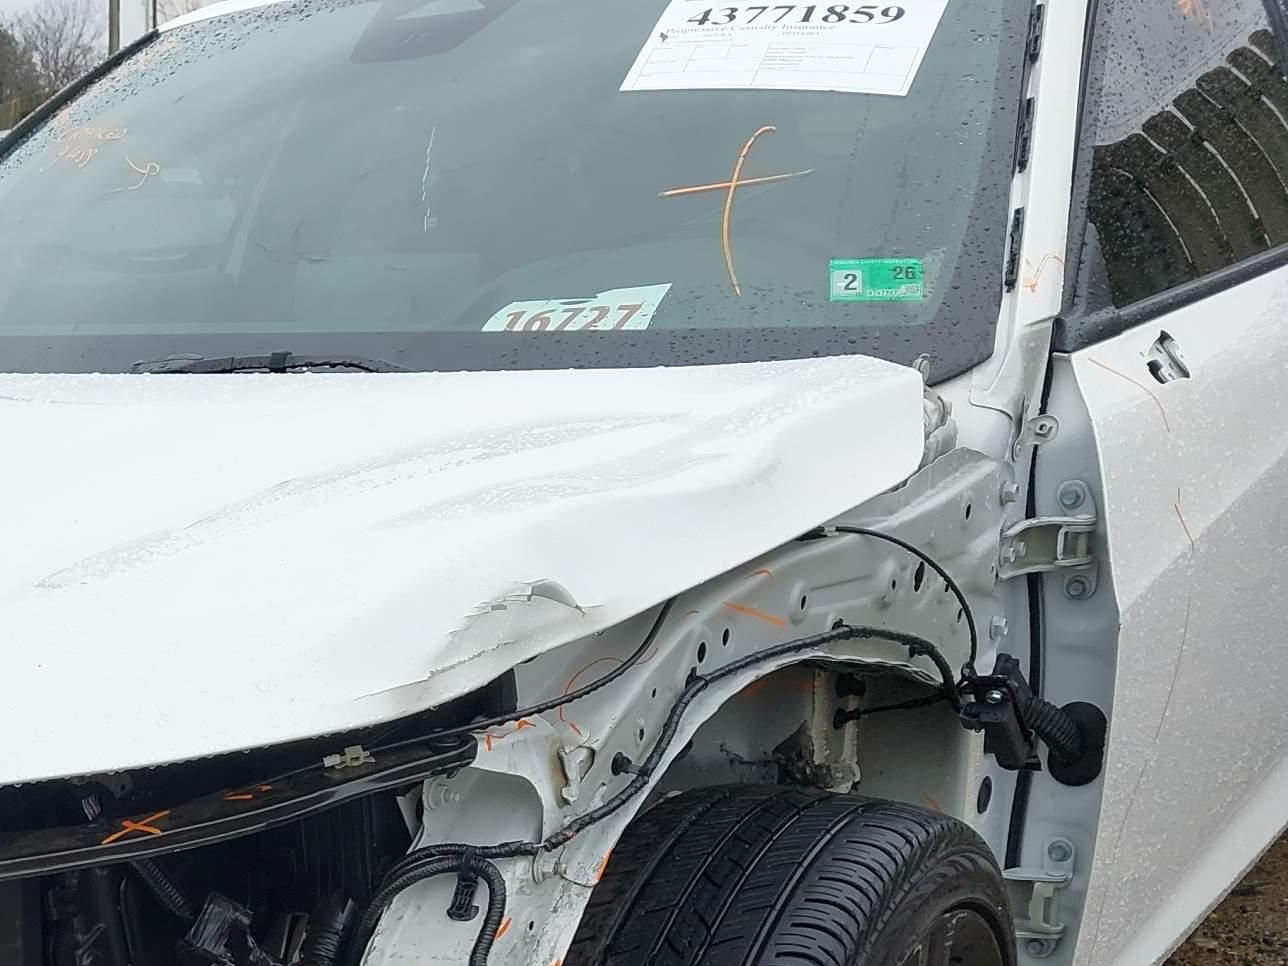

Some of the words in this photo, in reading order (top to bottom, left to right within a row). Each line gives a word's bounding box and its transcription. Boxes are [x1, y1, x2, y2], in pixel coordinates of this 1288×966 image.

[687, 5, 906, 26] 43771859
[843, 273, 858, 291] 2
[893, 265, 917, 280] 26
[505, 303, 644, 331] 16727
